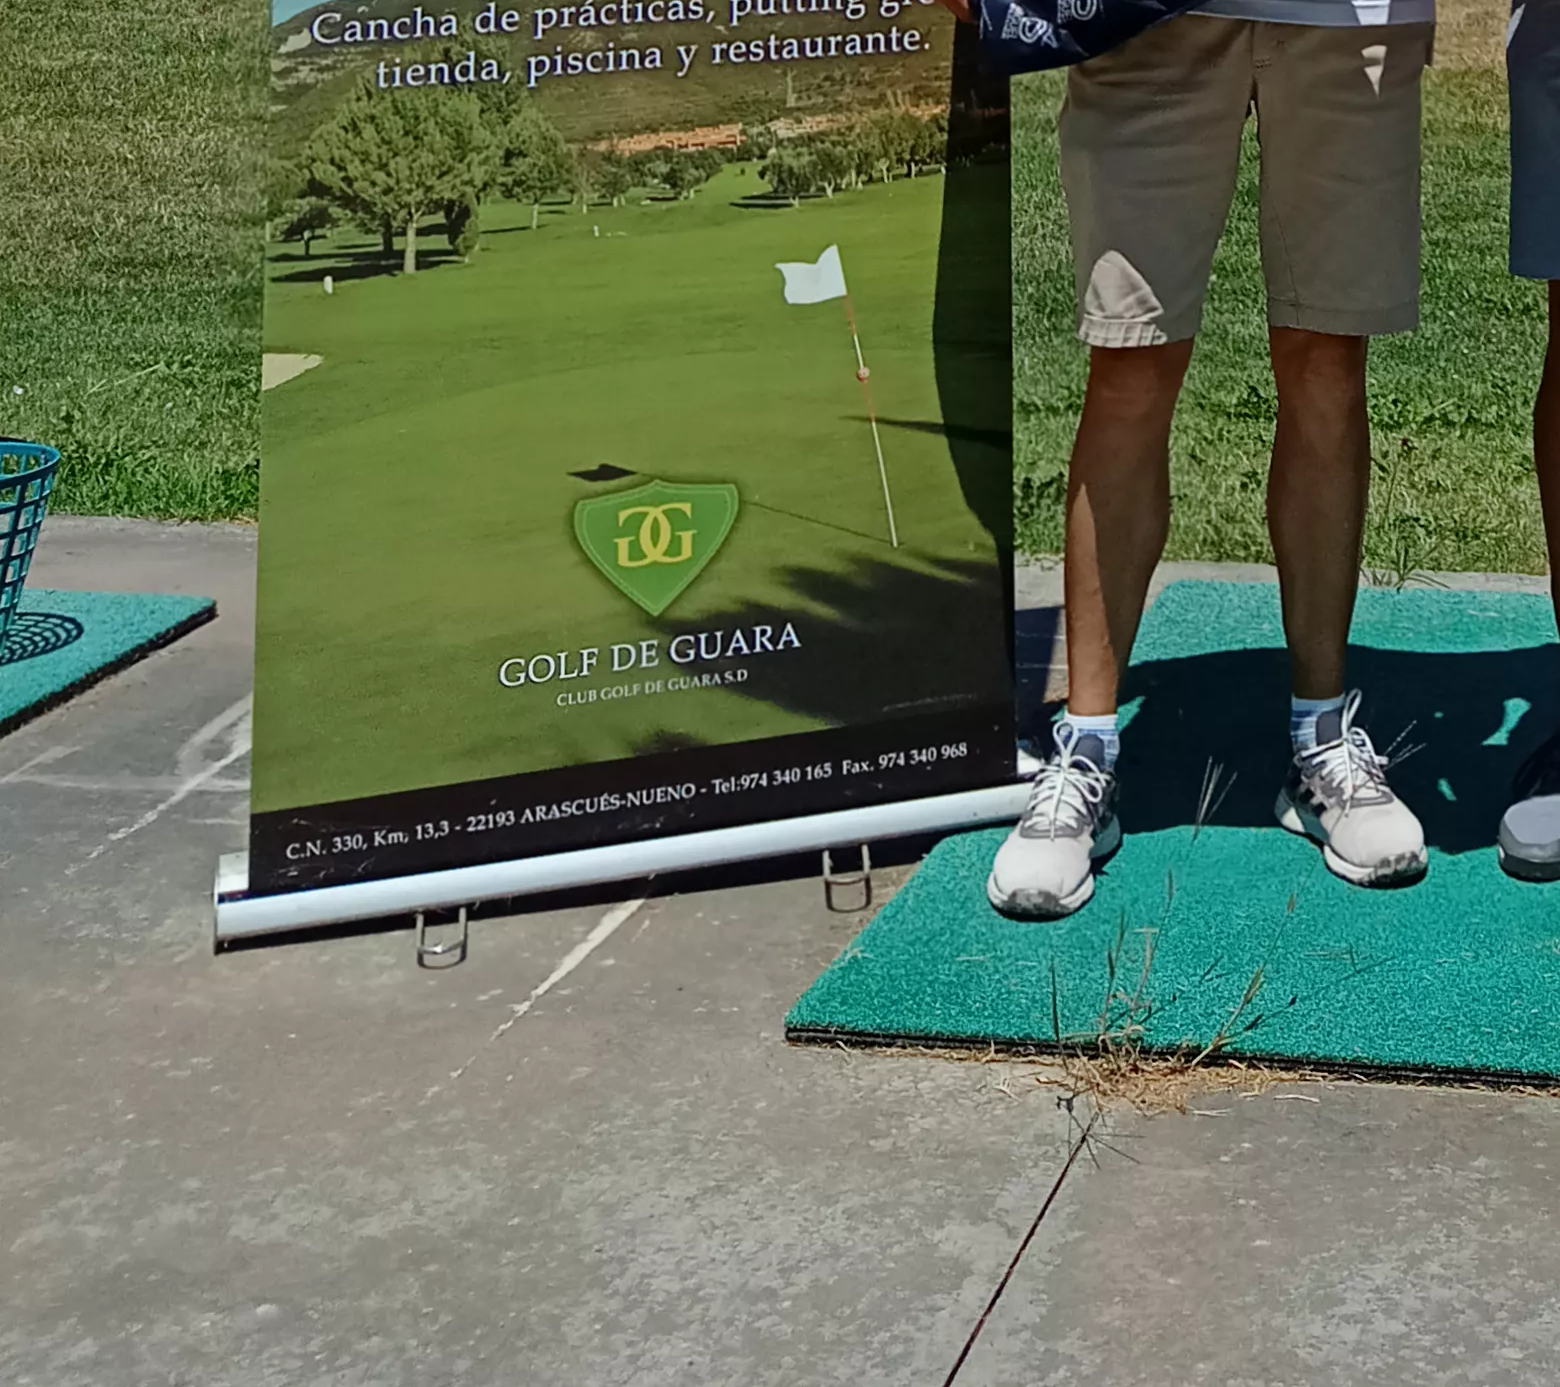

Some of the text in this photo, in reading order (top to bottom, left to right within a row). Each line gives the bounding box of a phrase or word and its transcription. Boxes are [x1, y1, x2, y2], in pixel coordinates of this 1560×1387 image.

[311, 6, 458, 44] Cancha
[474, 1, 520, 34] de
[376, 26, 931, 89] tienda, piscina y restaurante.
[499, 621, 802, 688] GOLF DE GUARA
[556, 668, 749, 708] CLUB GOLF DE GUARA S.D
[285, 839, 328, 860] C.N.
[332, 832, 369, 853] 330,
[415, 819, 450, 841] 13,3
[466, 809, 516, 833] 22193
[772, 765, 802, 786] 340
[805, 760, 833, 780] 165
[841, 758, 875, 776] Fax.
[878, 750, 906, 770] 974
[910, 745, 938, 765] 340
[940, 740, 969, 760] 968
